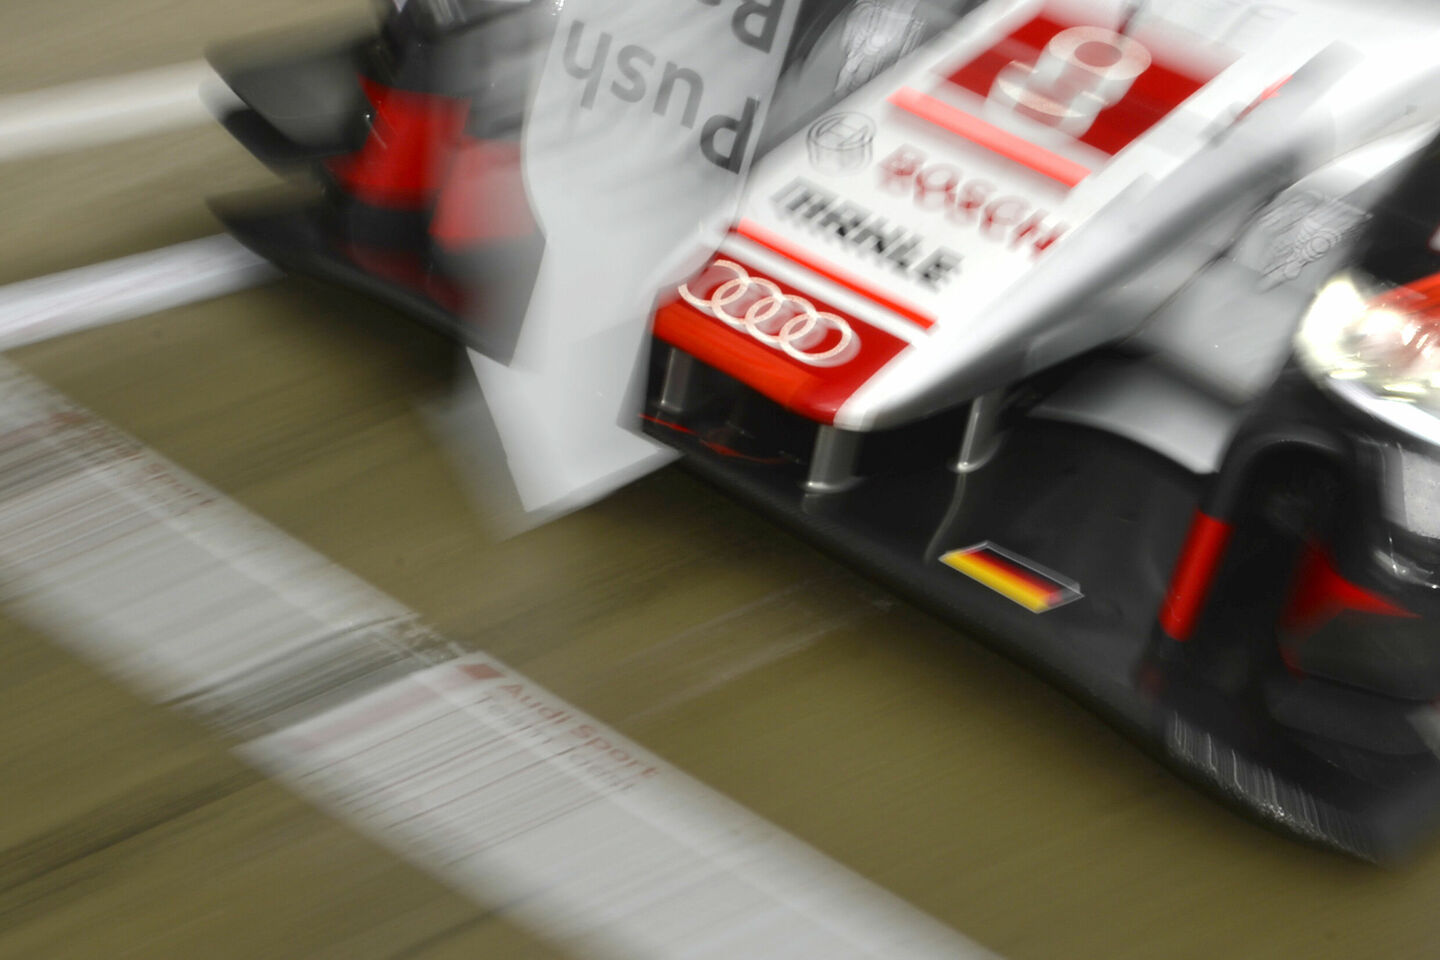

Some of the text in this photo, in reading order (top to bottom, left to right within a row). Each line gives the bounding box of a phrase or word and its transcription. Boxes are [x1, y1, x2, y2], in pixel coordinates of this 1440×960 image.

[561, 19, 760, 174] Push
[876, 143, 1072, 261] BOSCH
[497, 683, 660, 779] Audi Sport
